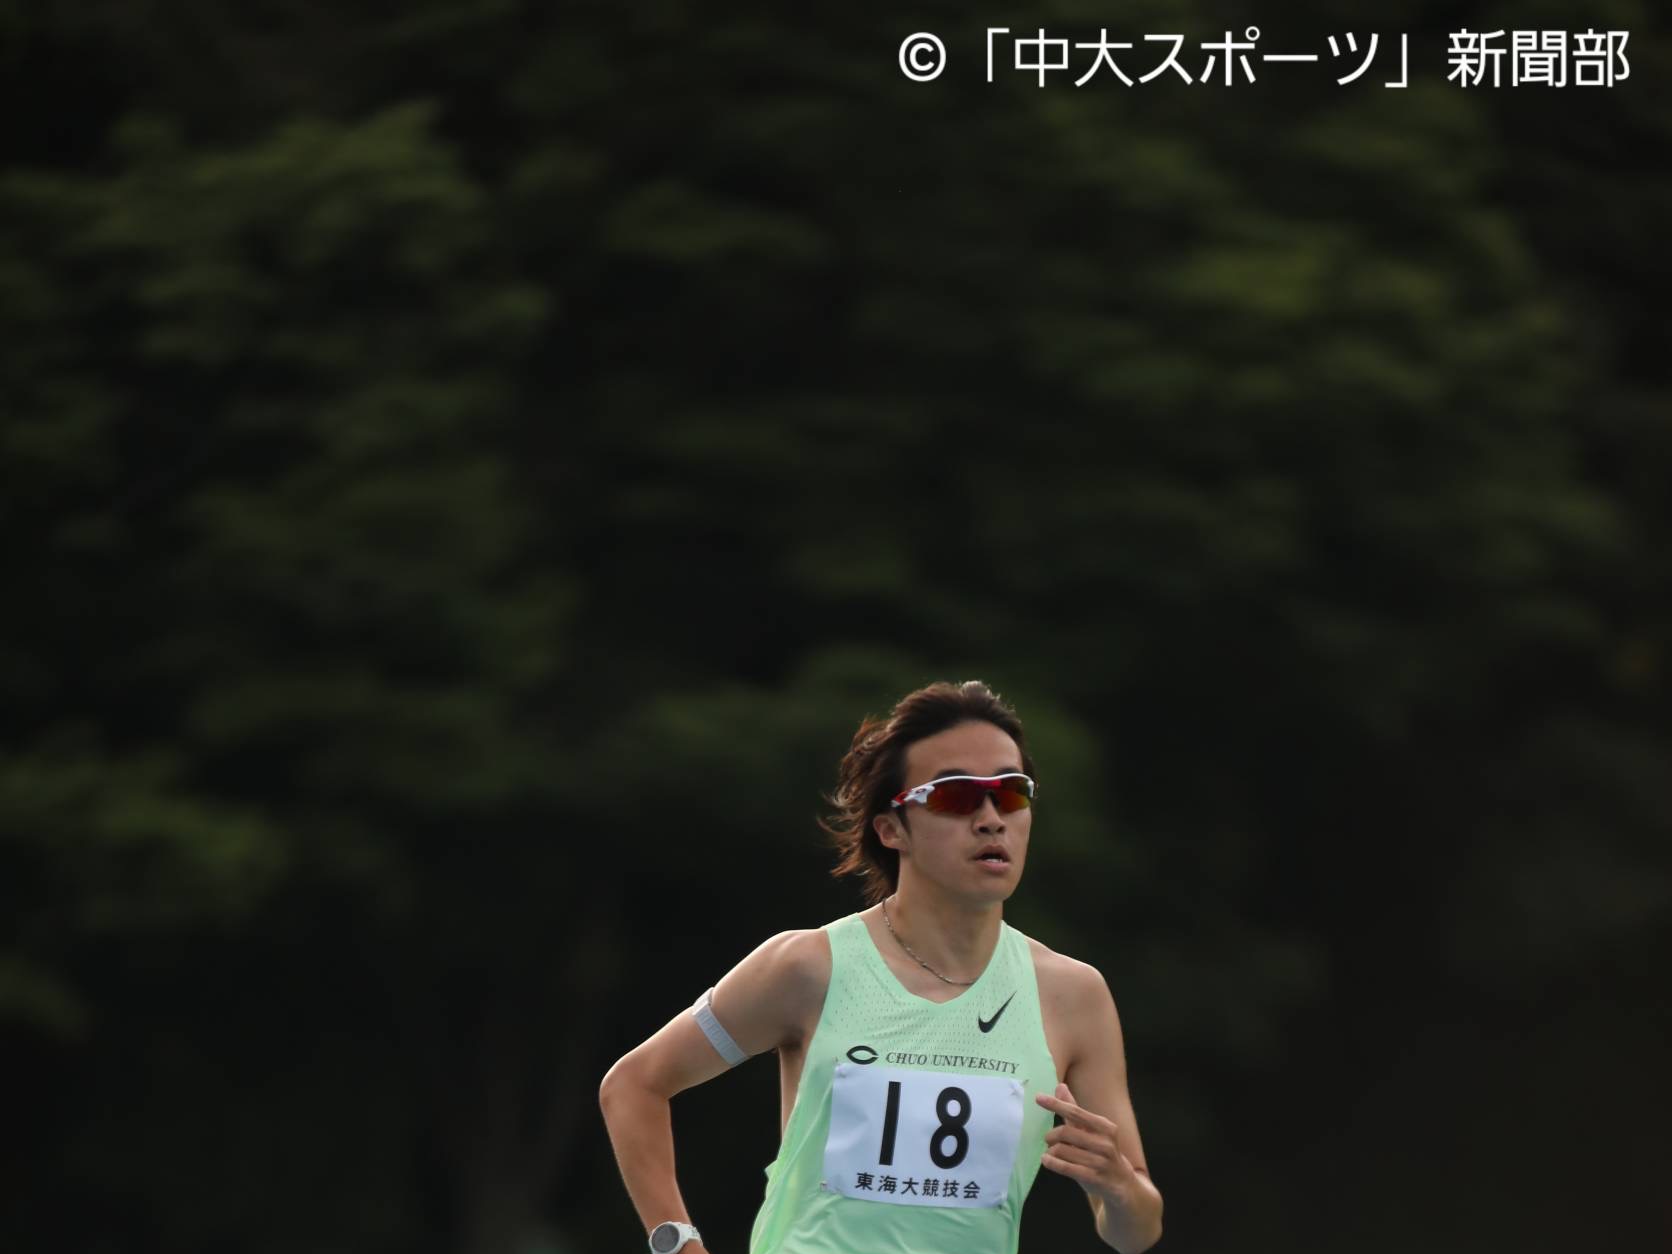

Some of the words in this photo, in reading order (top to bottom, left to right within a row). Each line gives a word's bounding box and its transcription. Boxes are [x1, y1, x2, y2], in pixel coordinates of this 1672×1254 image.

[885, 1051, 928, 1066] CHUO
[933, 1052, 1020, 1074] UNIVERSITY
[879, 1081, 972, 1169] 18
[854, 1172, 981, 1199] 東海大競技会
